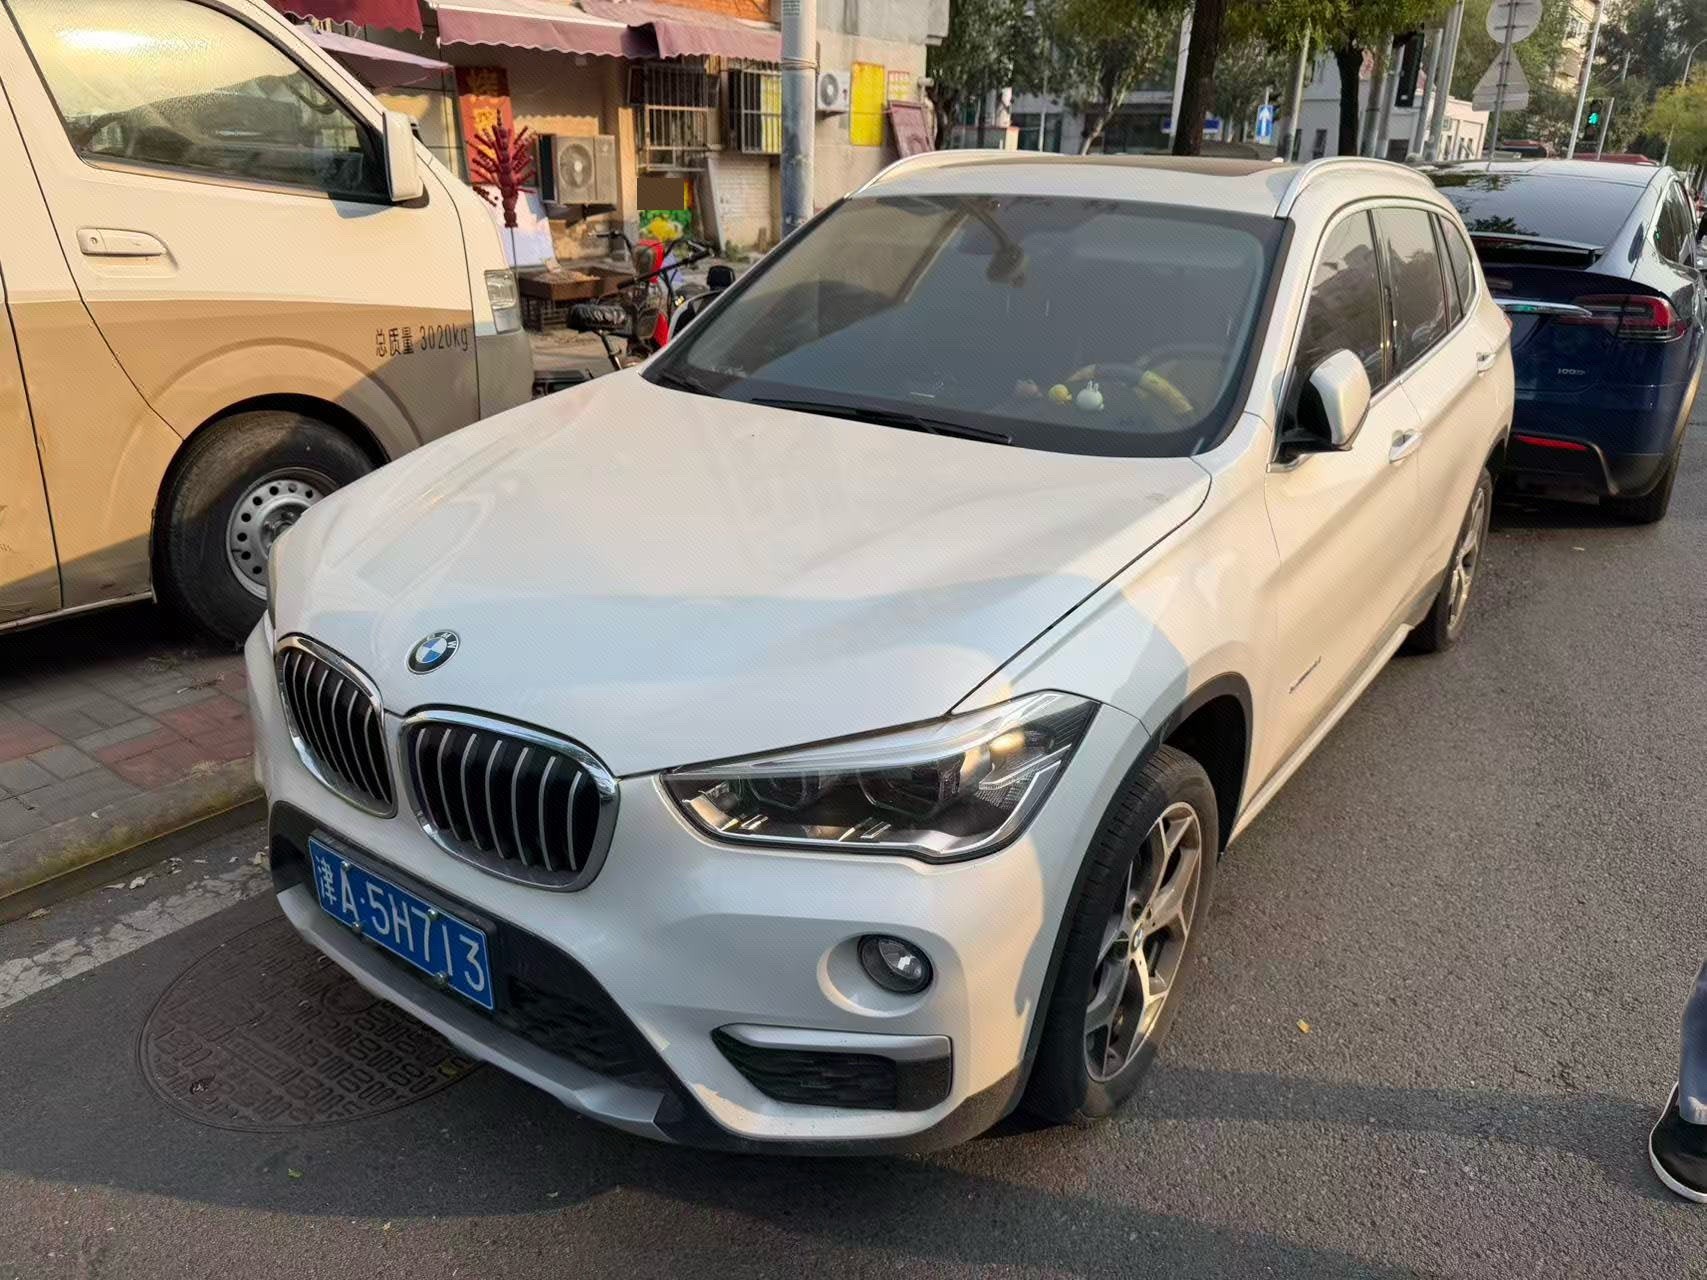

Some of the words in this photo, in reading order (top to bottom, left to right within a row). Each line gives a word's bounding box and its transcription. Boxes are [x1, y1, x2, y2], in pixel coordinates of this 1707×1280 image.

[376, 326, 414, 357] 总质量
[419, 323, 468, 352] 3020kg
